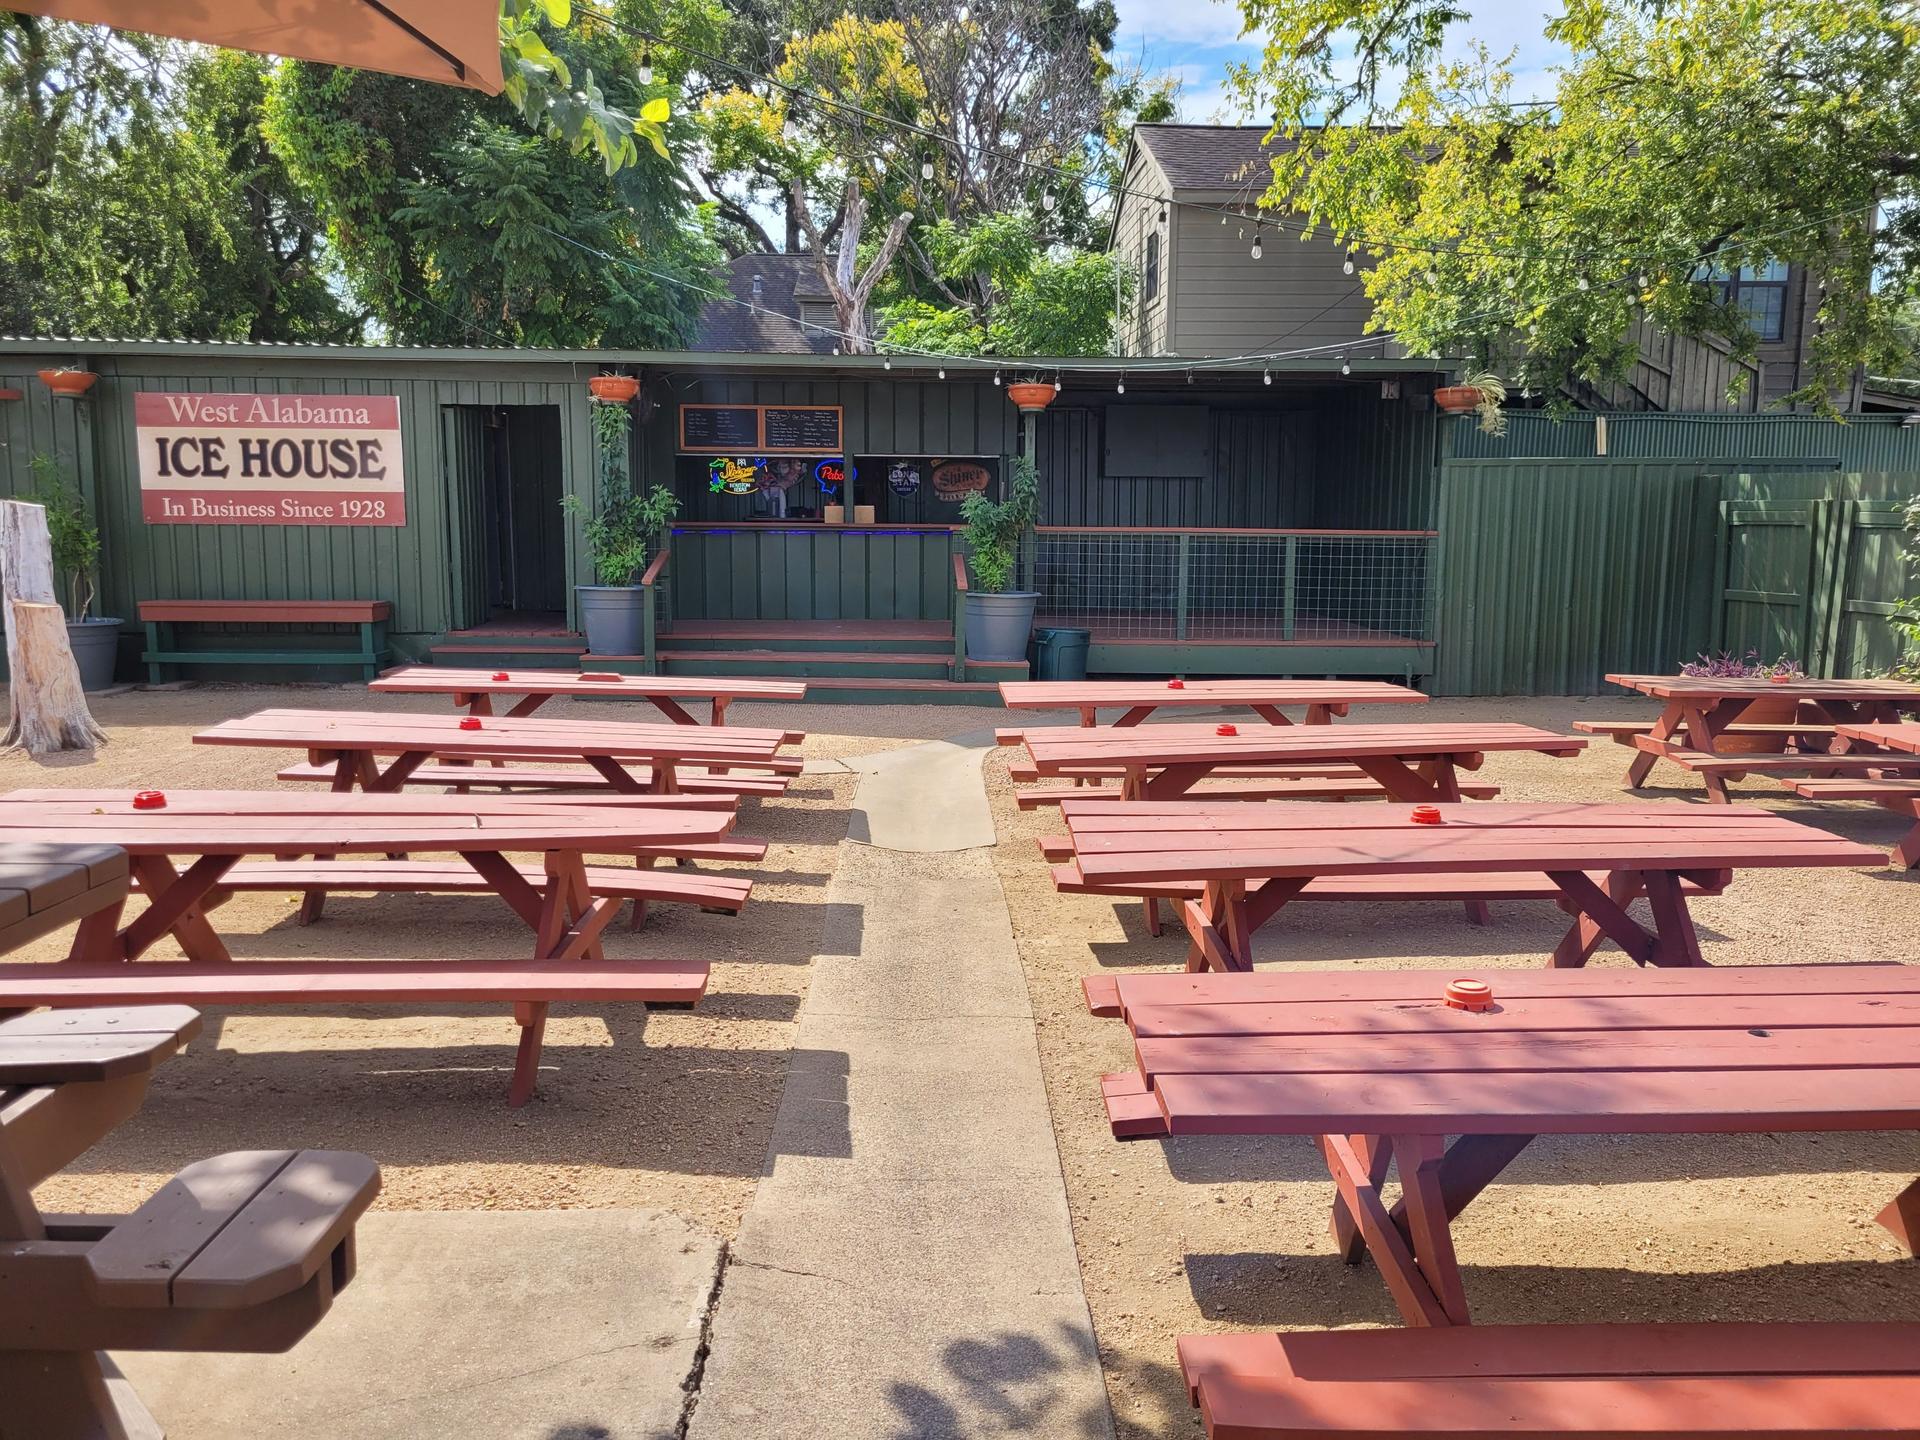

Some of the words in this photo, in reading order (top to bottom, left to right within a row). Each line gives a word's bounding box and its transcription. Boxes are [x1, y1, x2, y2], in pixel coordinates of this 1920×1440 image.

[164, 396, 239, 424] West
[245, 397, 370, 425] Alabama
[155, 436, 230, 479] ICE
[239, 438, 387, 481] HOUSE
[162, 497, 186, 517] In
[191, 497, 276, 518] Business
[281, 498, 334, 518] Since
[340, 499, 386, 519] 1928
